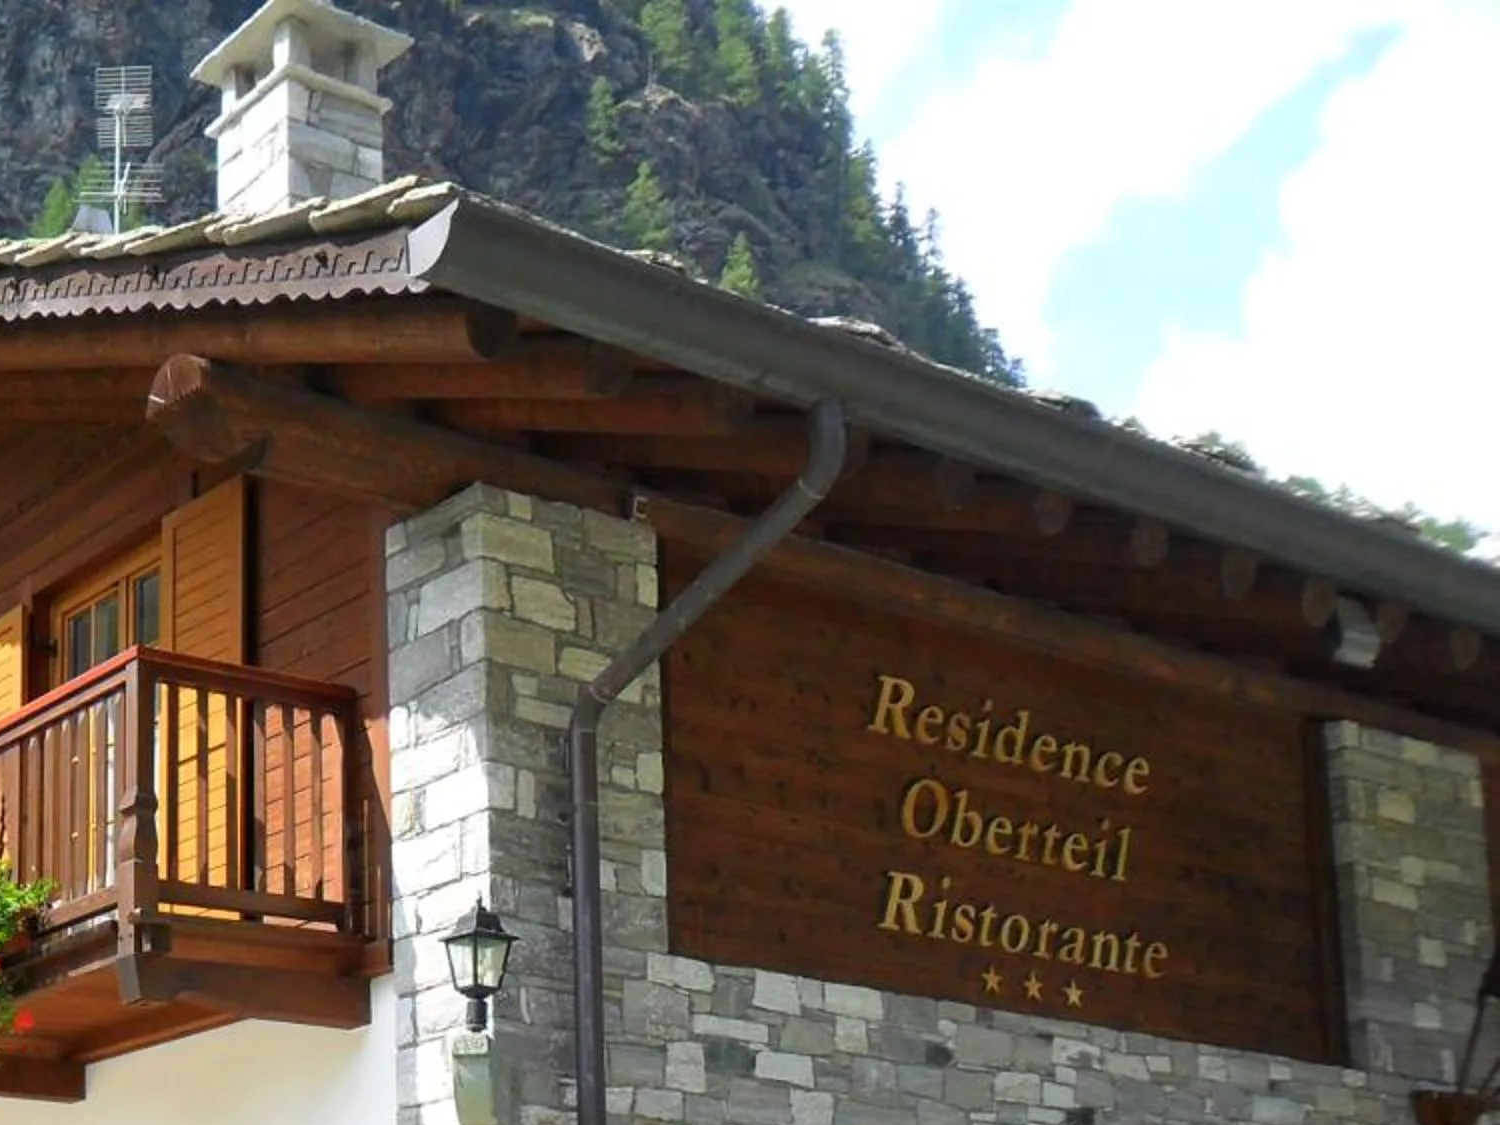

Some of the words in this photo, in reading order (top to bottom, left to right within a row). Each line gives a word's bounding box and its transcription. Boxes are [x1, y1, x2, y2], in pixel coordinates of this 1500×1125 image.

[868, 675, 1150, 794] Residence
[903, 779, 1131, 881] Oberteil
[879, 872, 1168, 979] Ristorante
